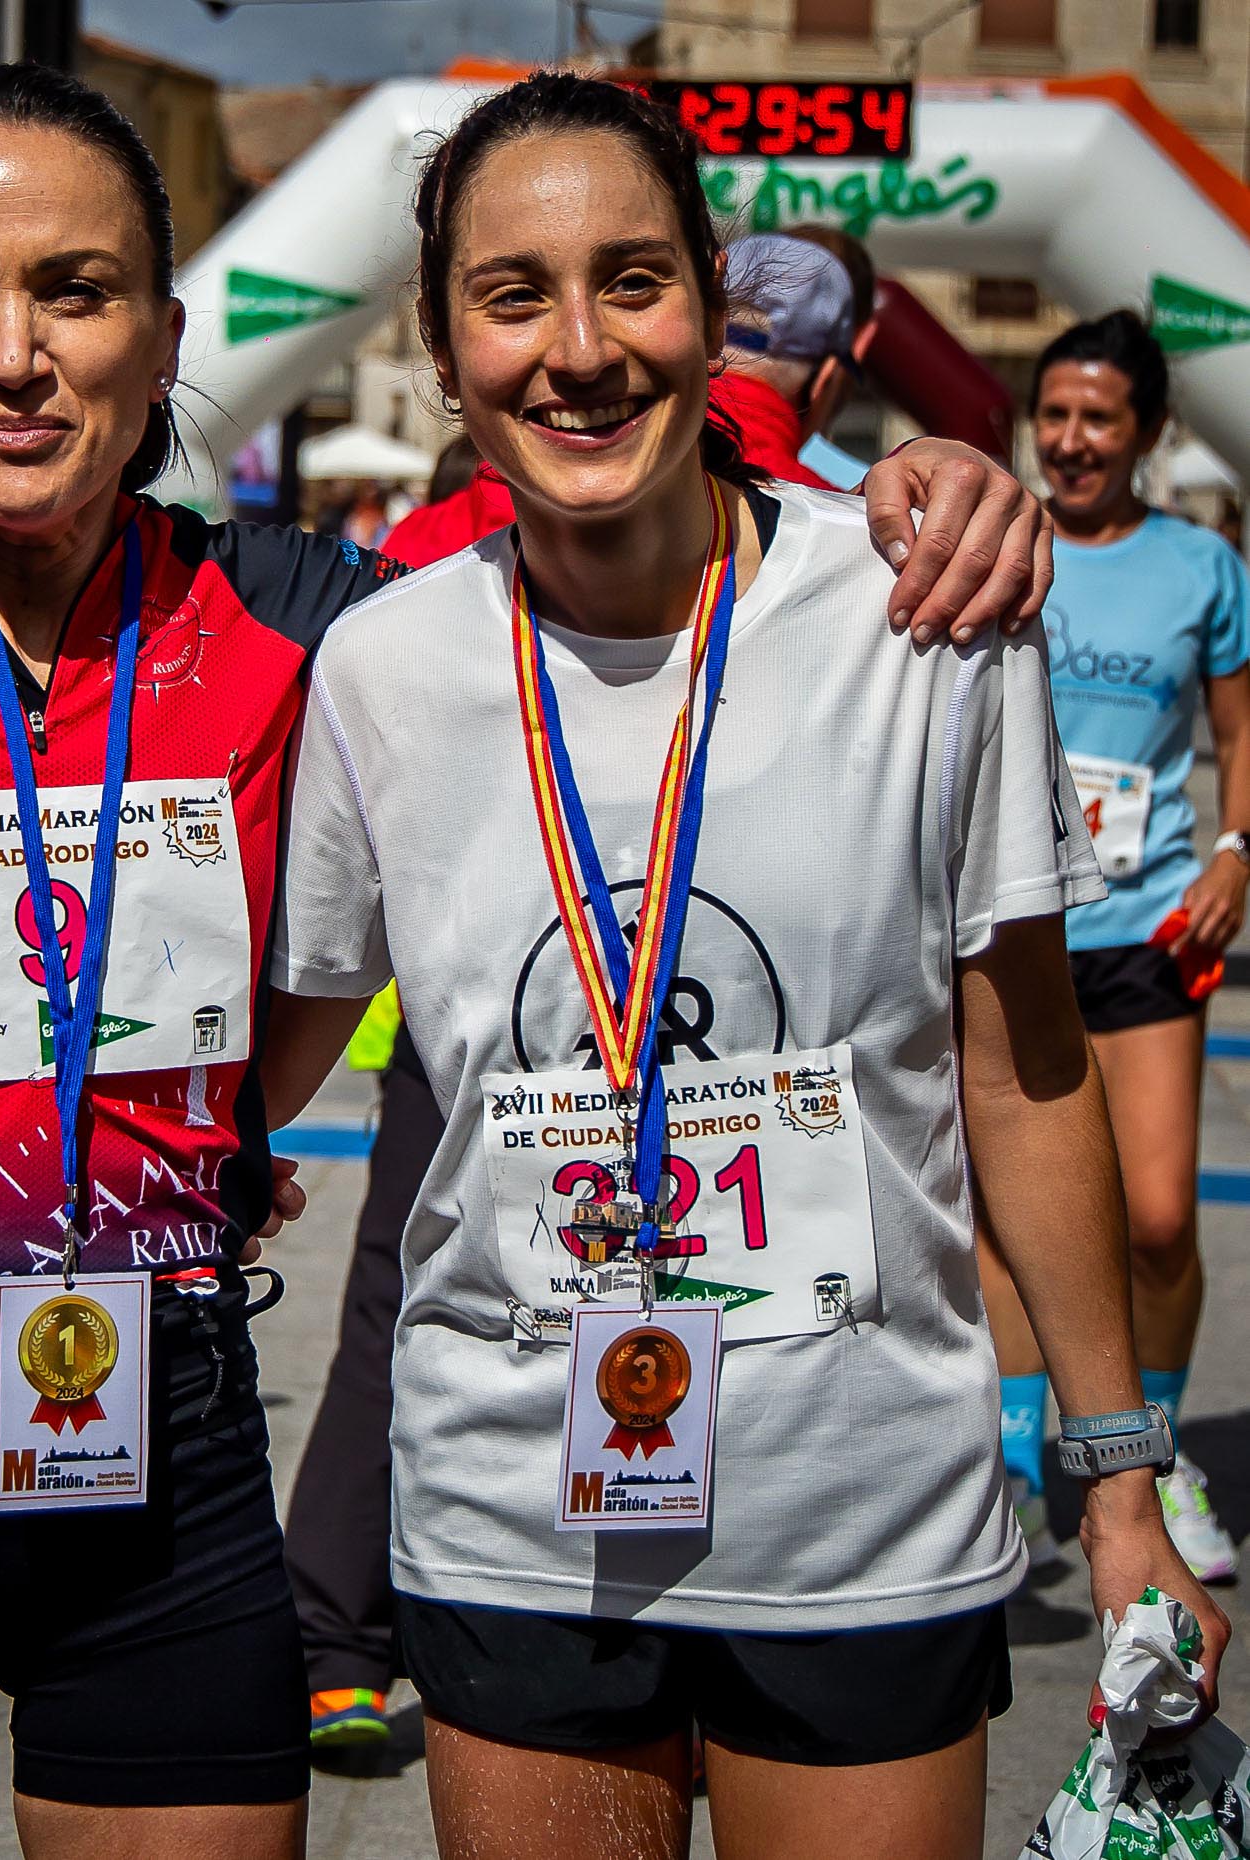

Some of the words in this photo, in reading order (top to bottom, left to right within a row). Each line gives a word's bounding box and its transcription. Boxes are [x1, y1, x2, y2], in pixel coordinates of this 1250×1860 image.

[38, 800, 155, 830] MARAÓN
[186, 823, 219, 840] 2024
[15, 878, 88, 988] 9
[665, 1075, 767, 1106] ARATÓN
[800, 1094, 839, 1113] 2024
[502, 1130, 536, 1149] DE
[666, 1113, 761, 1140] ODRIGO
[550, 1277, 595, 1294] BLANCA
[58, 1324, 76, 1366] 1
[630, 1354, 657, 1394] 3
[56, 1386, 85, 1400] 2024
